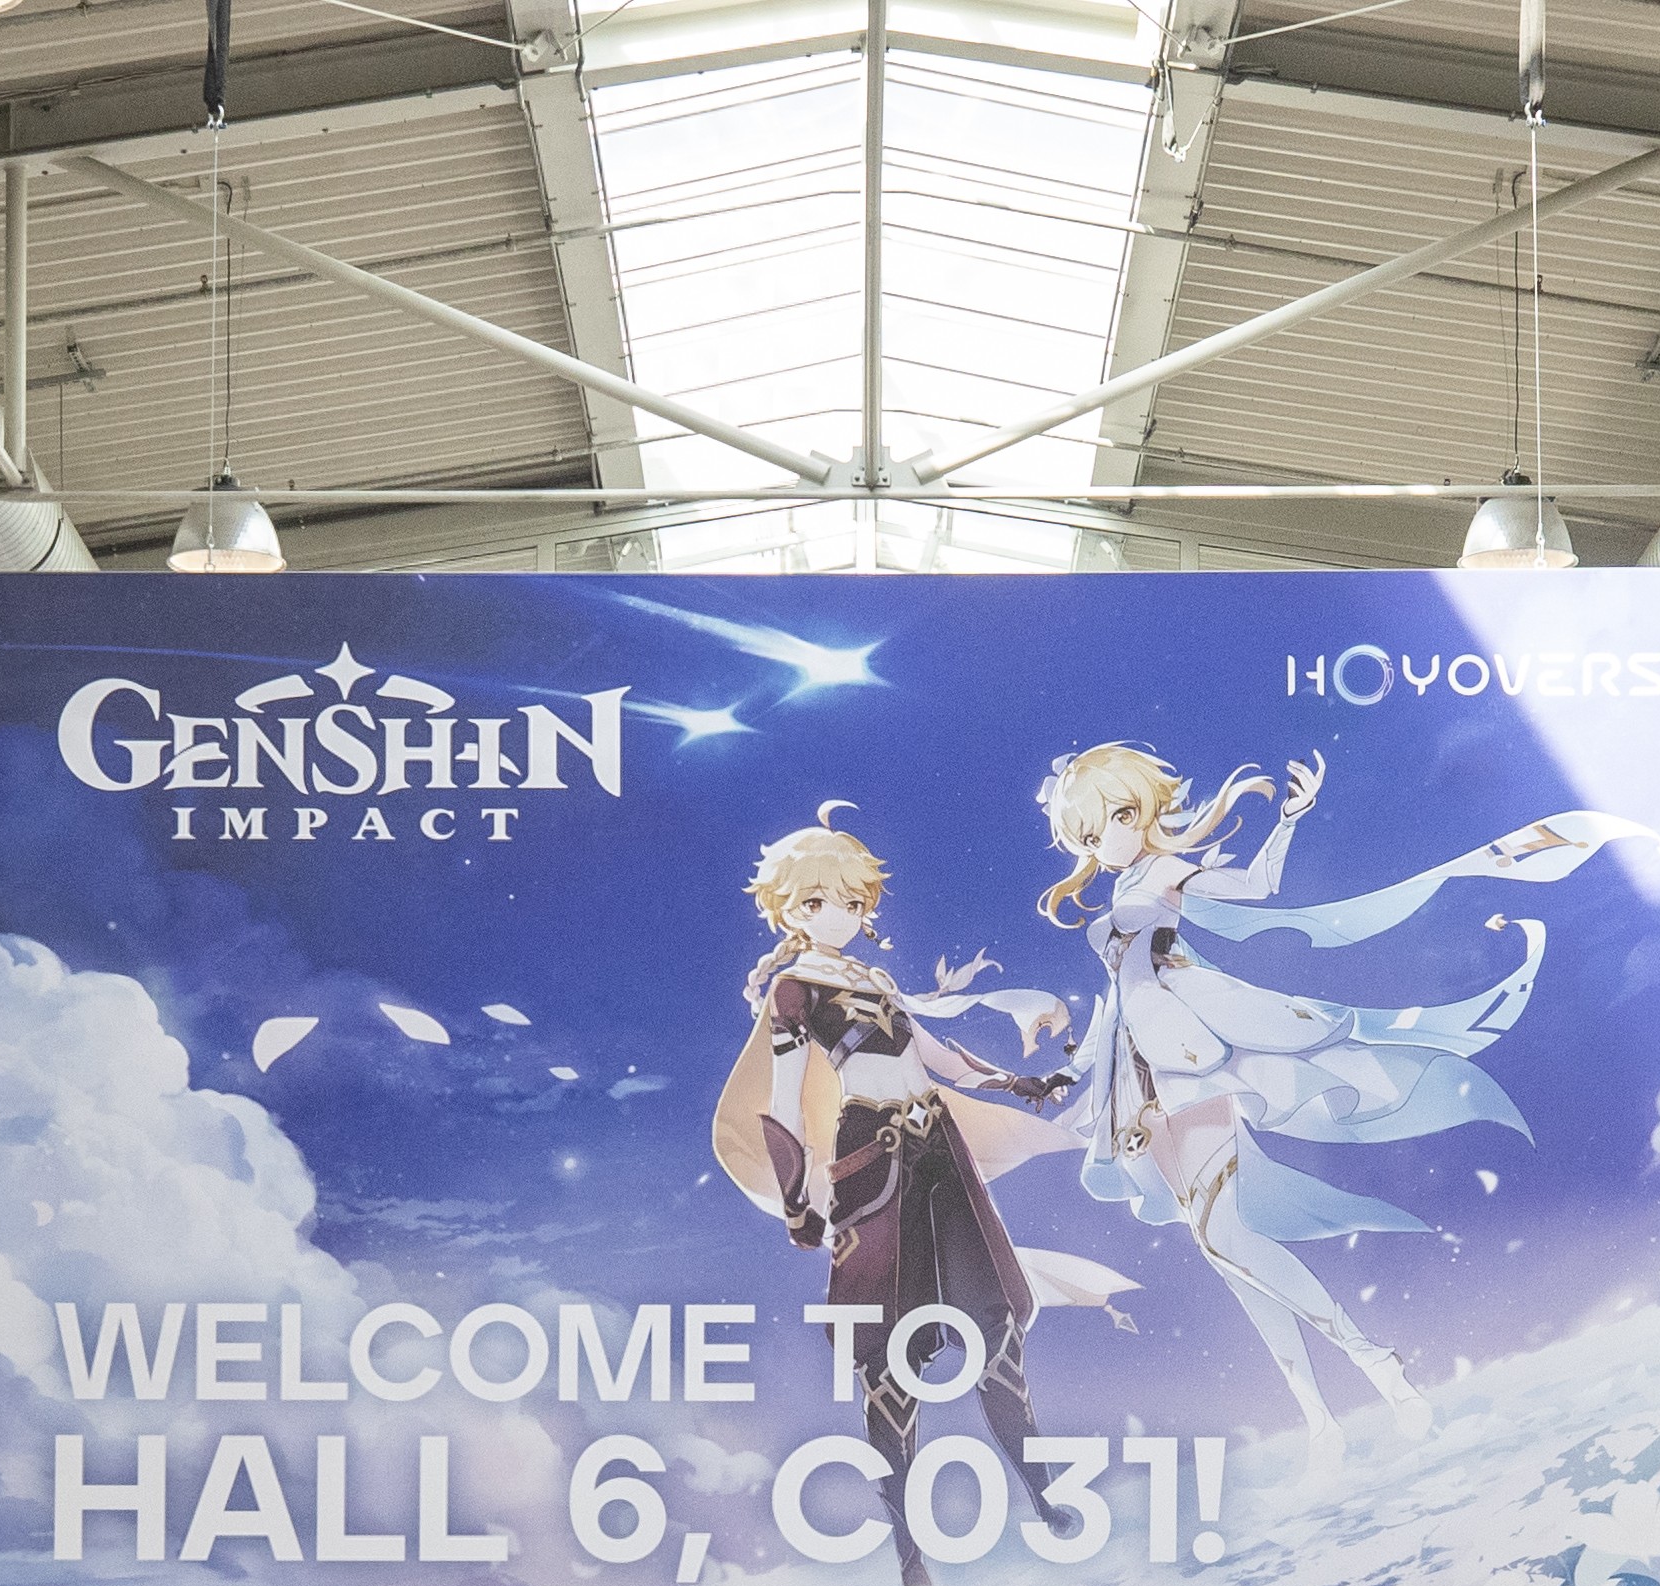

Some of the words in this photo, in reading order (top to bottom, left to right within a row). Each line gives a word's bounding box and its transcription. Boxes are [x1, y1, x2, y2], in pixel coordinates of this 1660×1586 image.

[57, 677, 632, 797] GENSHIN
[171, 807, 518, 840] IMPACT
[54, 1301, 756, 1402] WELCOME
[803, 1303, 987, 1403] TO
[53, 1434, 508, 1562] HALL
[569, 1434, 712, 1584] 6,
[771, 1434, 1227, 1563] C031!
